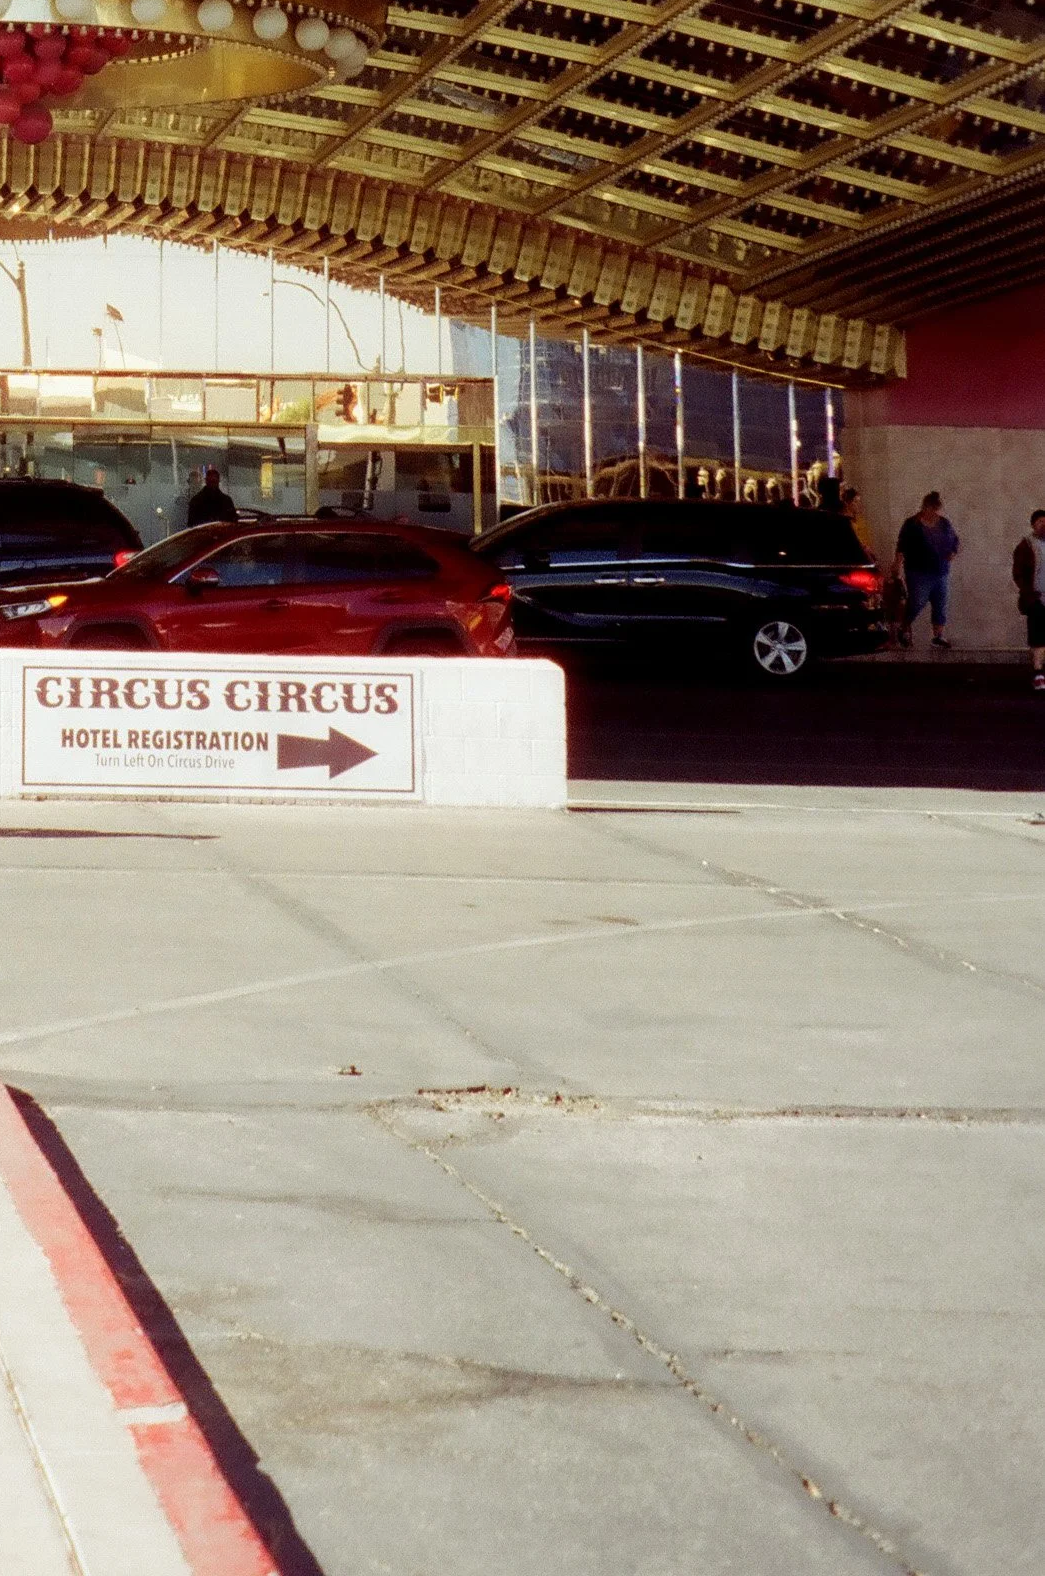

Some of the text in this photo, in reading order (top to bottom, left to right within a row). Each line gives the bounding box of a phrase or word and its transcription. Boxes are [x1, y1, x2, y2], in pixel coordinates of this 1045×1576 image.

[35, 676, 398, 715] CIRCUS CIRCUS
[61, 728, 269, 752] HOTEL REGISTRATION
[95, 753, 235, 770] Turn Left On Circus Drive
